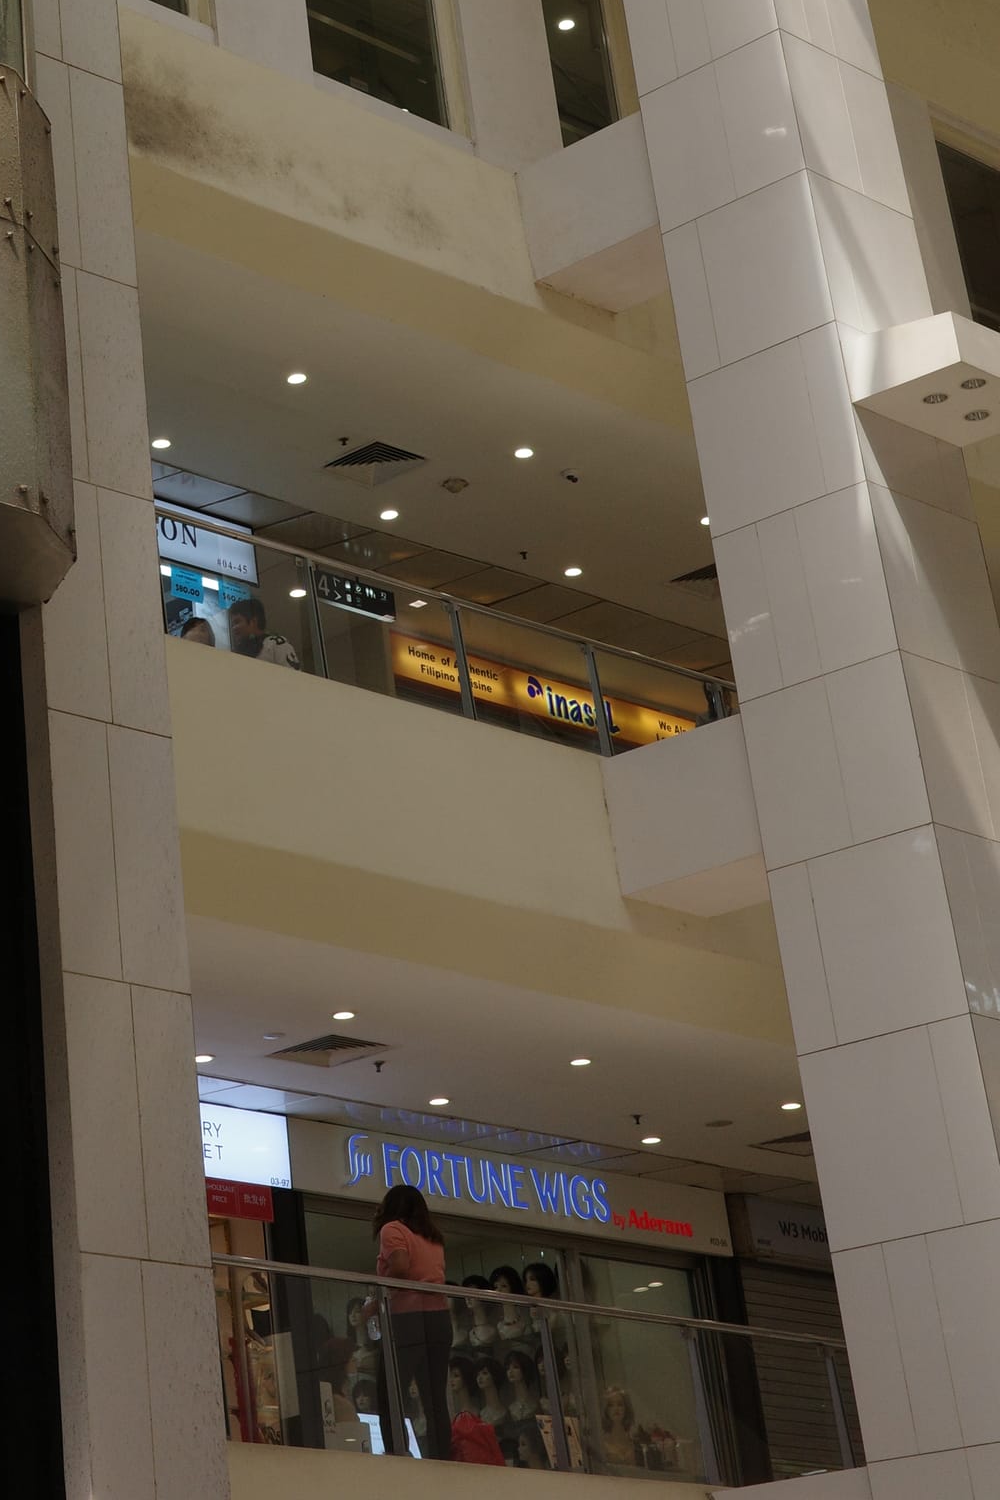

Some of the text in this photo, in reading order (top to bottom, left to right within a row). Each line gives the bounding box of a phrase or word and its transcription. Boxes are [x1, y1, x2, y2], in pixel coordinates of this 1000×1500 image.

[157, 516, 197, 548] ON
[318, 575, 330, 597] 4
[408, 645, 499, 681] Home of Ahentic
[421, 664, 492, 693] Filipino isine
[658, 720, 672, 733] We
[203, 1121, 222, 1138] RY
[203, 1143, 223, 1160] ET
[270, 1176, 290, 1188] 03-97
[382, 1142, 693, 1237] FORTUNE WIGS by Aderans
[778, 1220, 798, 1238] W3
